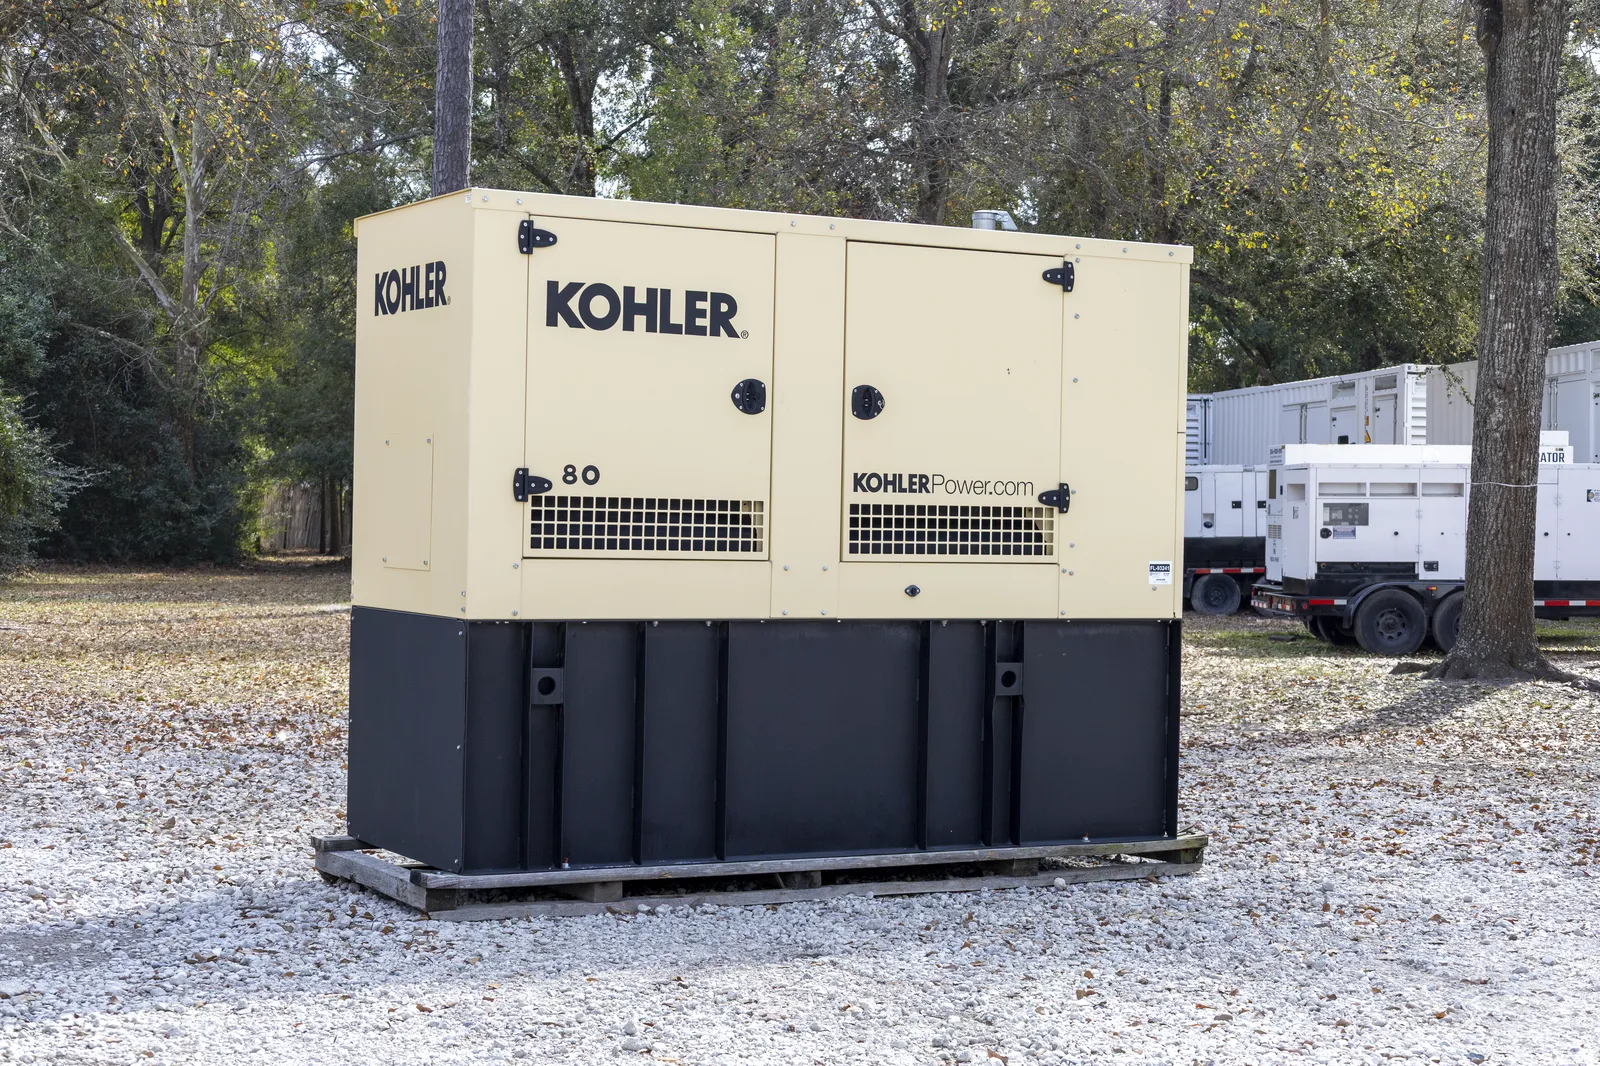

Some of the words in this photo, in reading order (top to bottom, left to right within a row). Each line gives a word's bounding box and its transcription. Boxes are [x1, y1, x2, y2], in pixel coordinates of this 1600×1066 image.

[1539, 452, 1565, 463] ATOR
[562, 464, 600, 486] 80
[853, 472, 1034, 496] KOHLERPower.com
